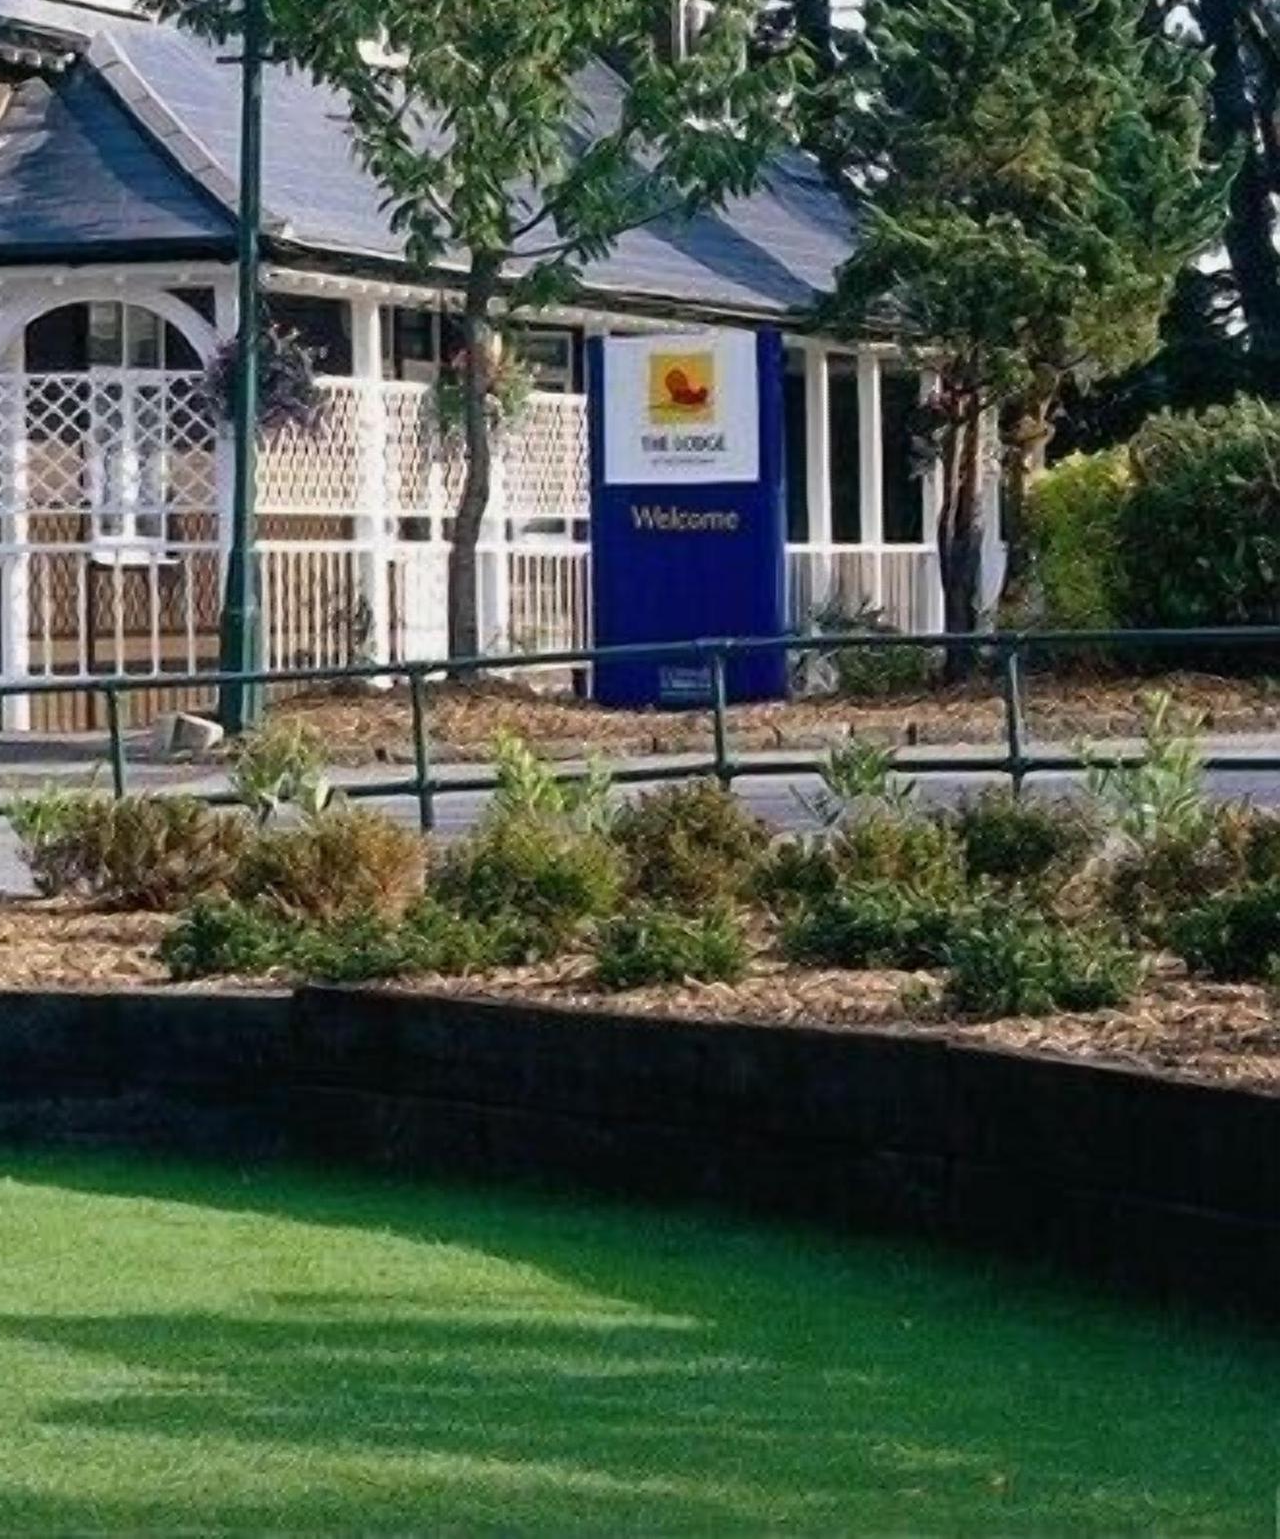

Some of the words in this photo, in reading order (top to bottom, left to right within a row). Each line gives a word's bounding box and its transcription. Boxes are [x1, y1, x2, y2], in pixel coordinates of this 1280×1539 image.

[641, 434, 668, 452] THE
[671, 433, 727, 451] LODGE
[631, 505, 739, 530] Welcome
